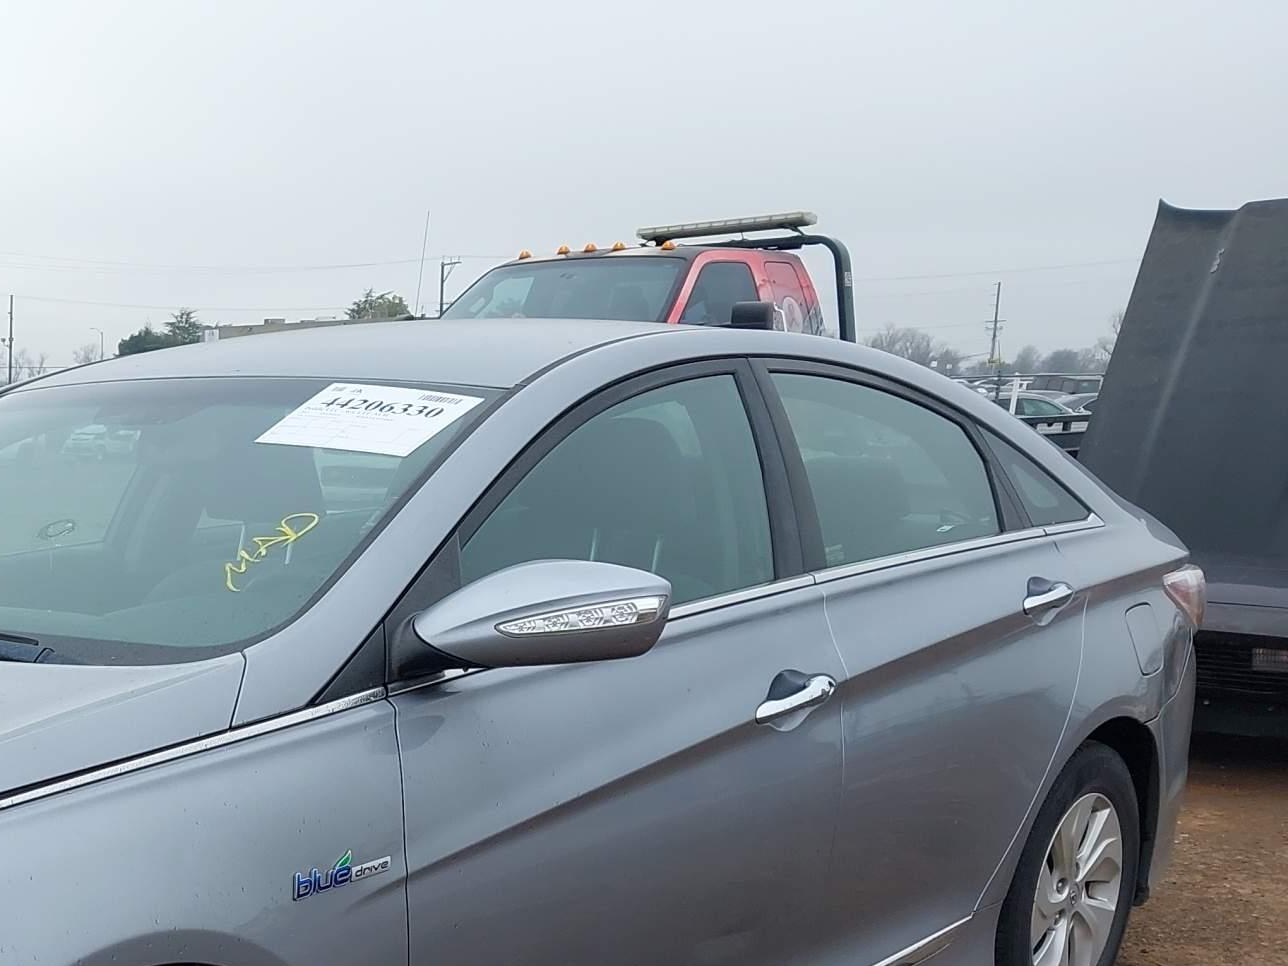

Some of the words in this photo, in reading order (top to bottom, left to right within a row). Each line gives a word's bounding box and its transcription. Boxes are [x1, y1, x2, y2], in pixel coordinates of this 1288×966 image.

[320, 396, 445, 419] 44206330
[293, 863, 352, 901] blue
[354, 860, 389, 878] drive
